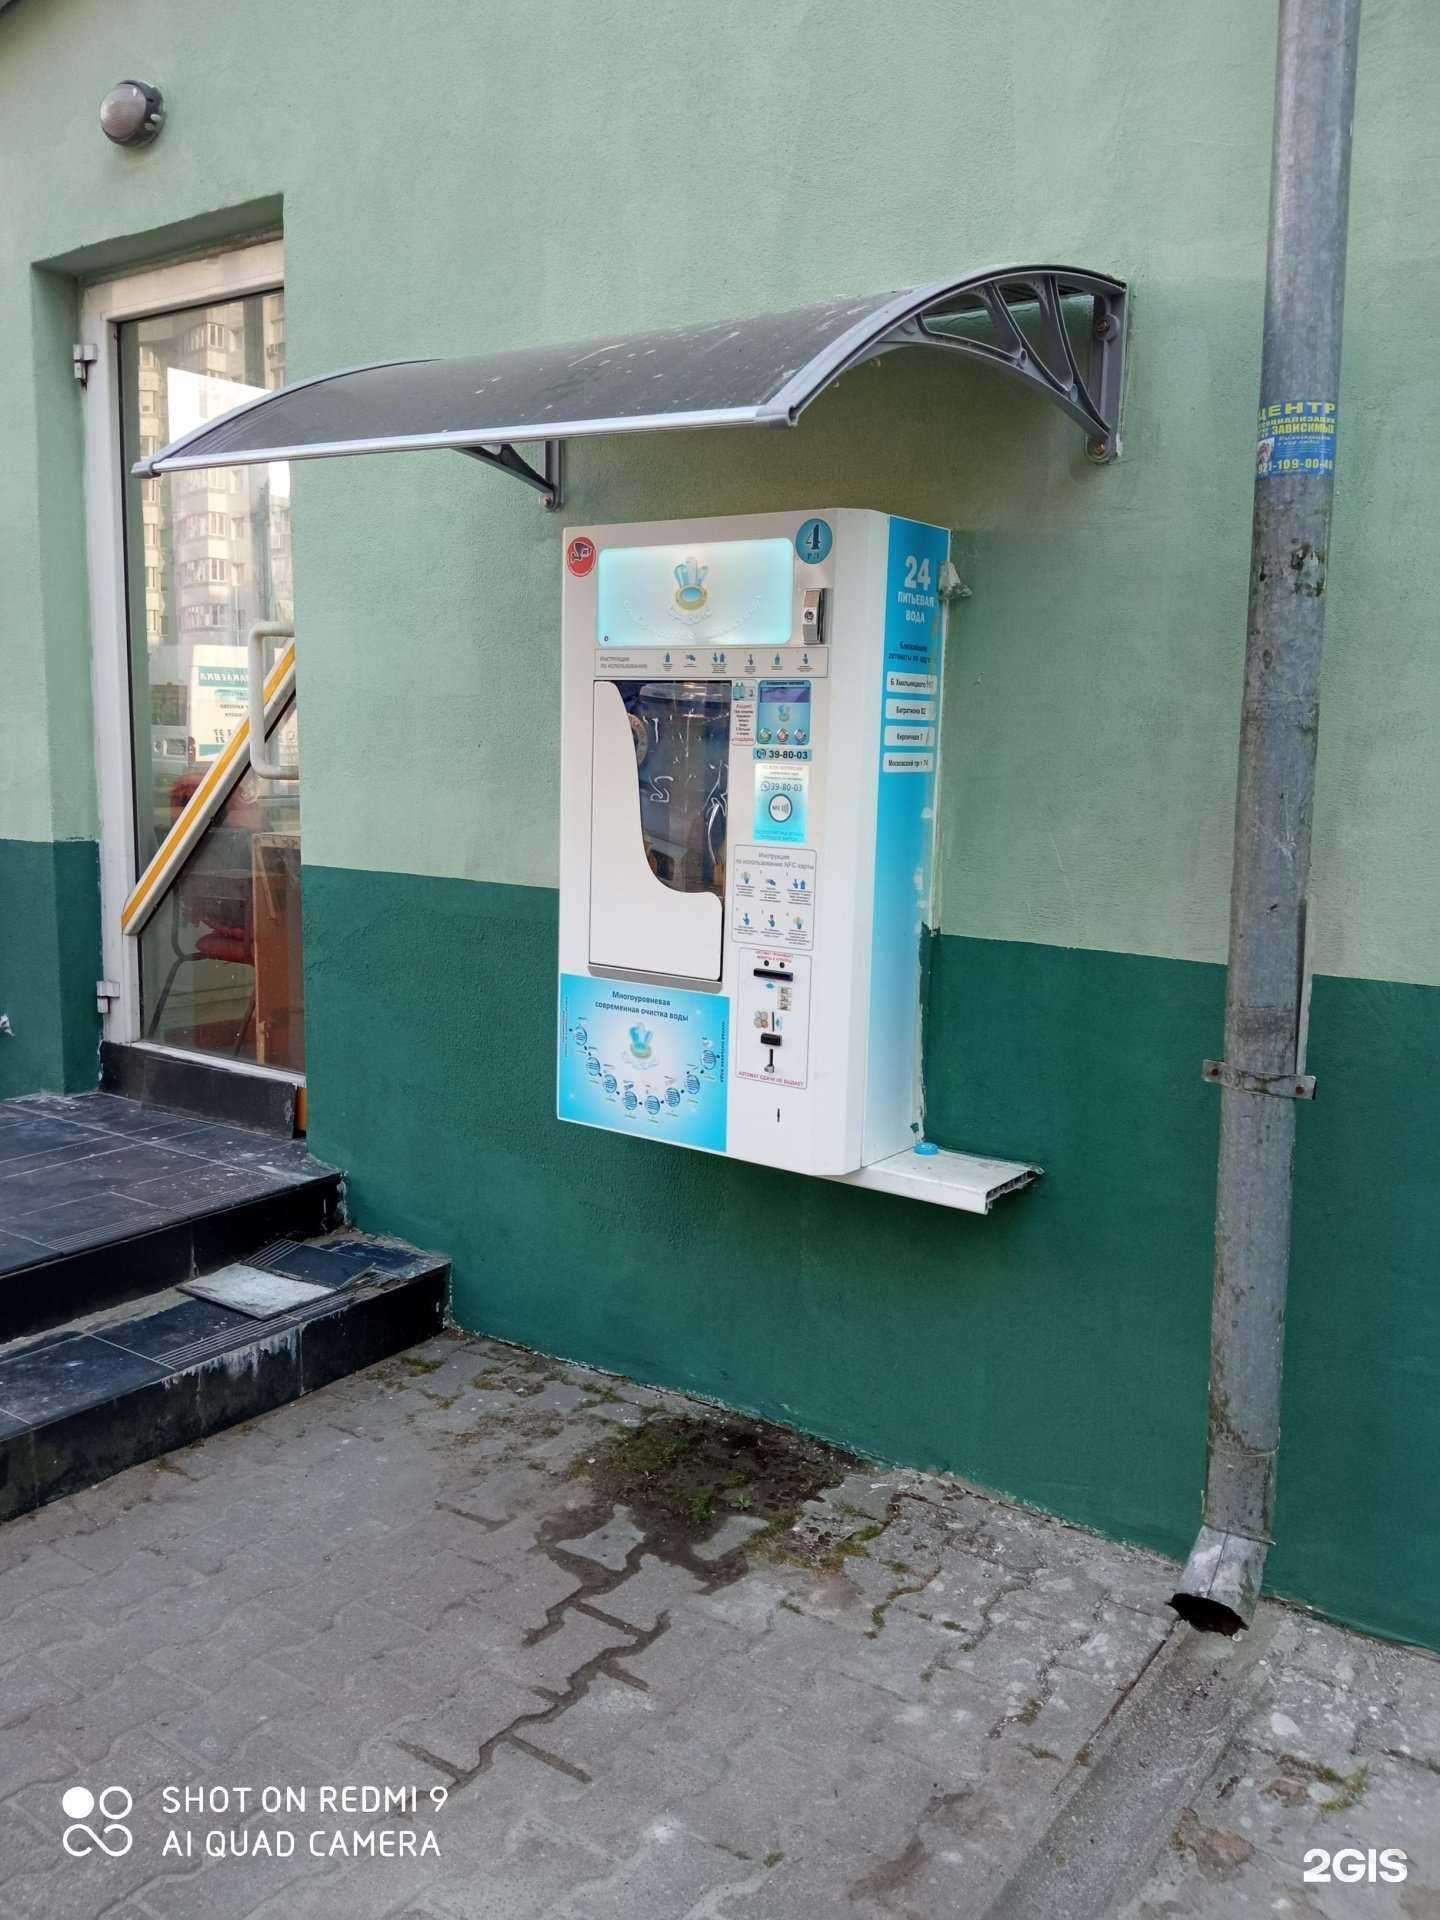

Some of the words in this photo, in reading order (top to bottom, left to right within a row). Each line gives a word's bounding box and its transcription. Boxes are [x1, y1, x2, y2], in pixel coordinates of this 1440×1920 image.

[1258, 402, 1336, 420] ЦЕНТР
[806, 524, 821, 550] 4
[904, 555, 931, 591] 24
[897, 591, 935, 608] ПИТЬЕВАЯ
[905, 609, 925, 624] ВОДА
[768, 750, 808, 760] 39-80-03
[612, 990, 671, 1007] Многоуровневая
[595, 1001, 640, 1014] современная
[640, 1008, 668, 1019] очистка
[669, 1012, 689, 1023] воды
